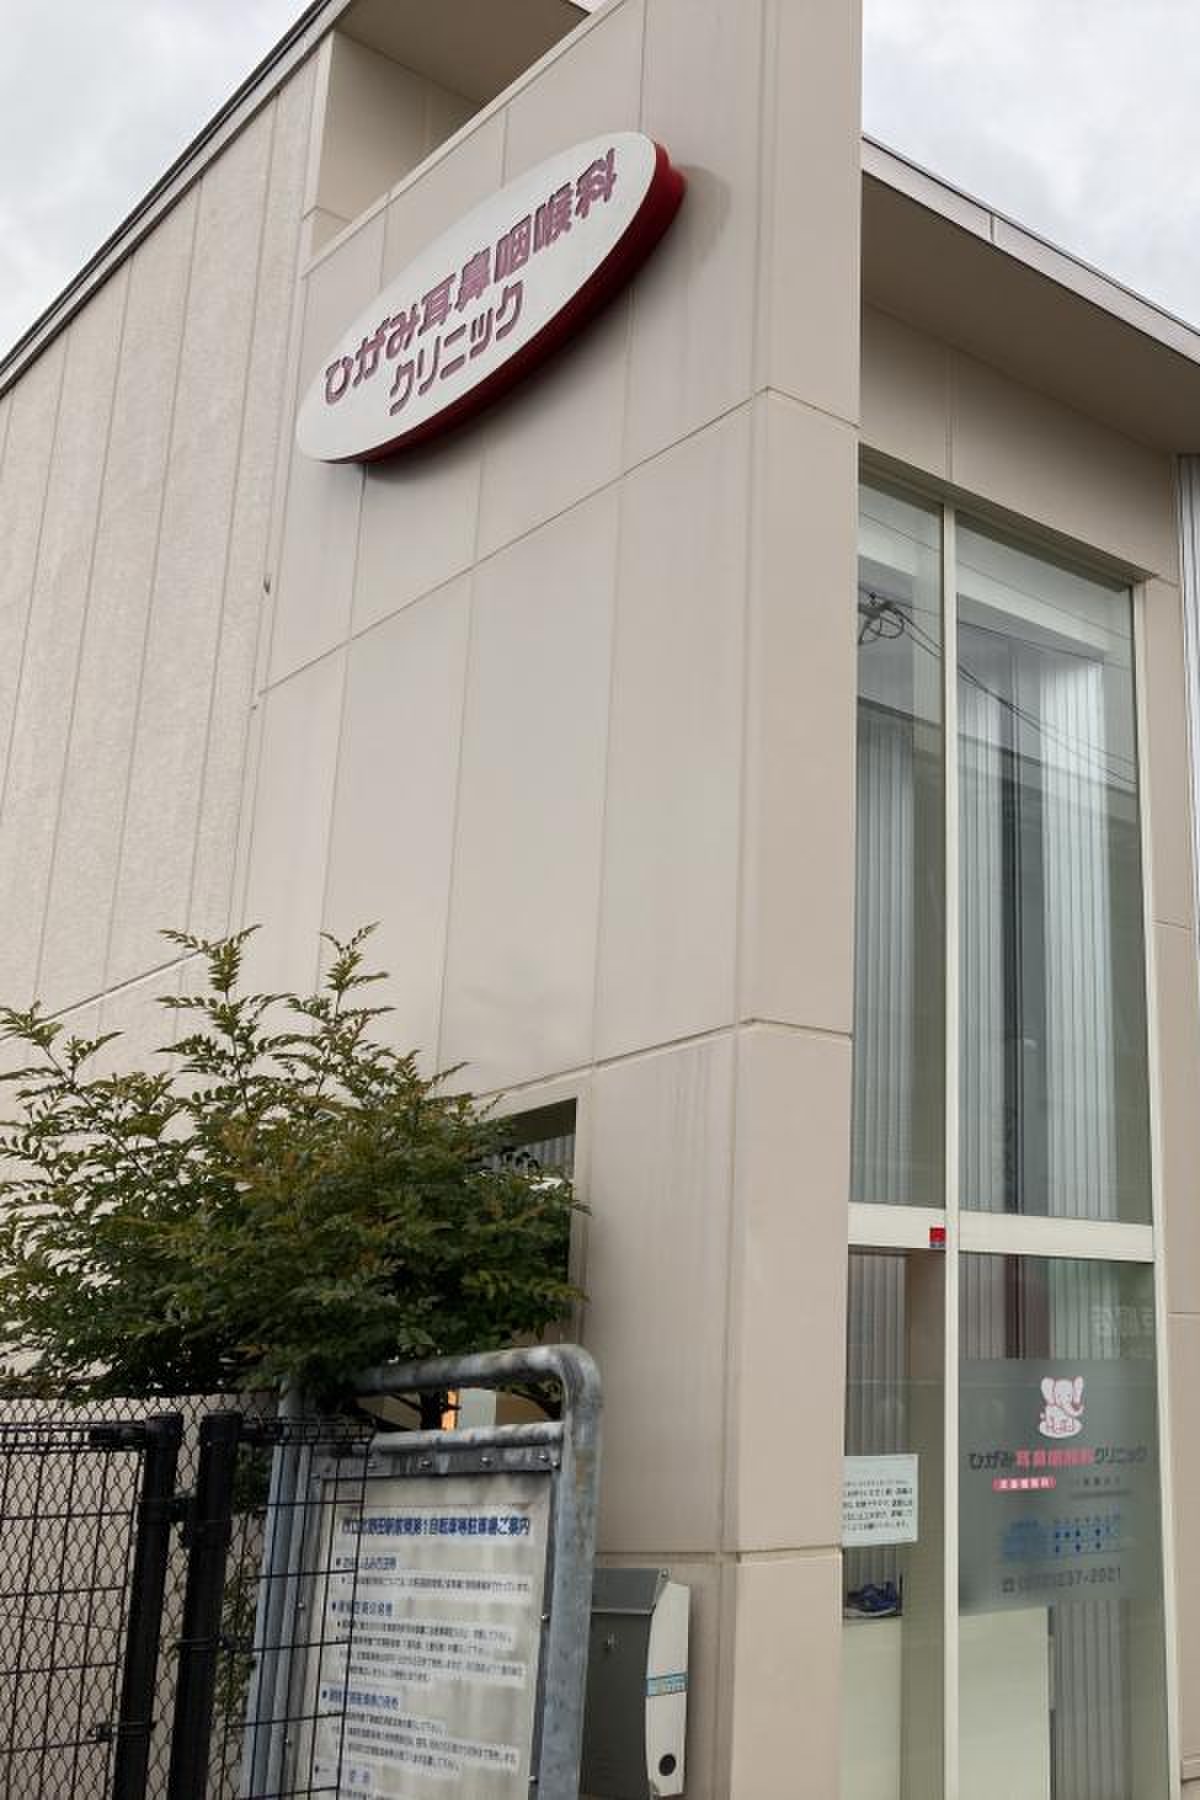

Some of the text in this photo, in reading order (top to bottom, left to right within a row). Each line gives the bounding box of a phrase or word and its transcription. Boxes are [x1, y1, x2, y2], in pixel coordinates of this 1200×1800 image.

[323, 147, 618, 405] ひがみ耳鼻咽喉科
[388, 280, 525, 416] クリニック
